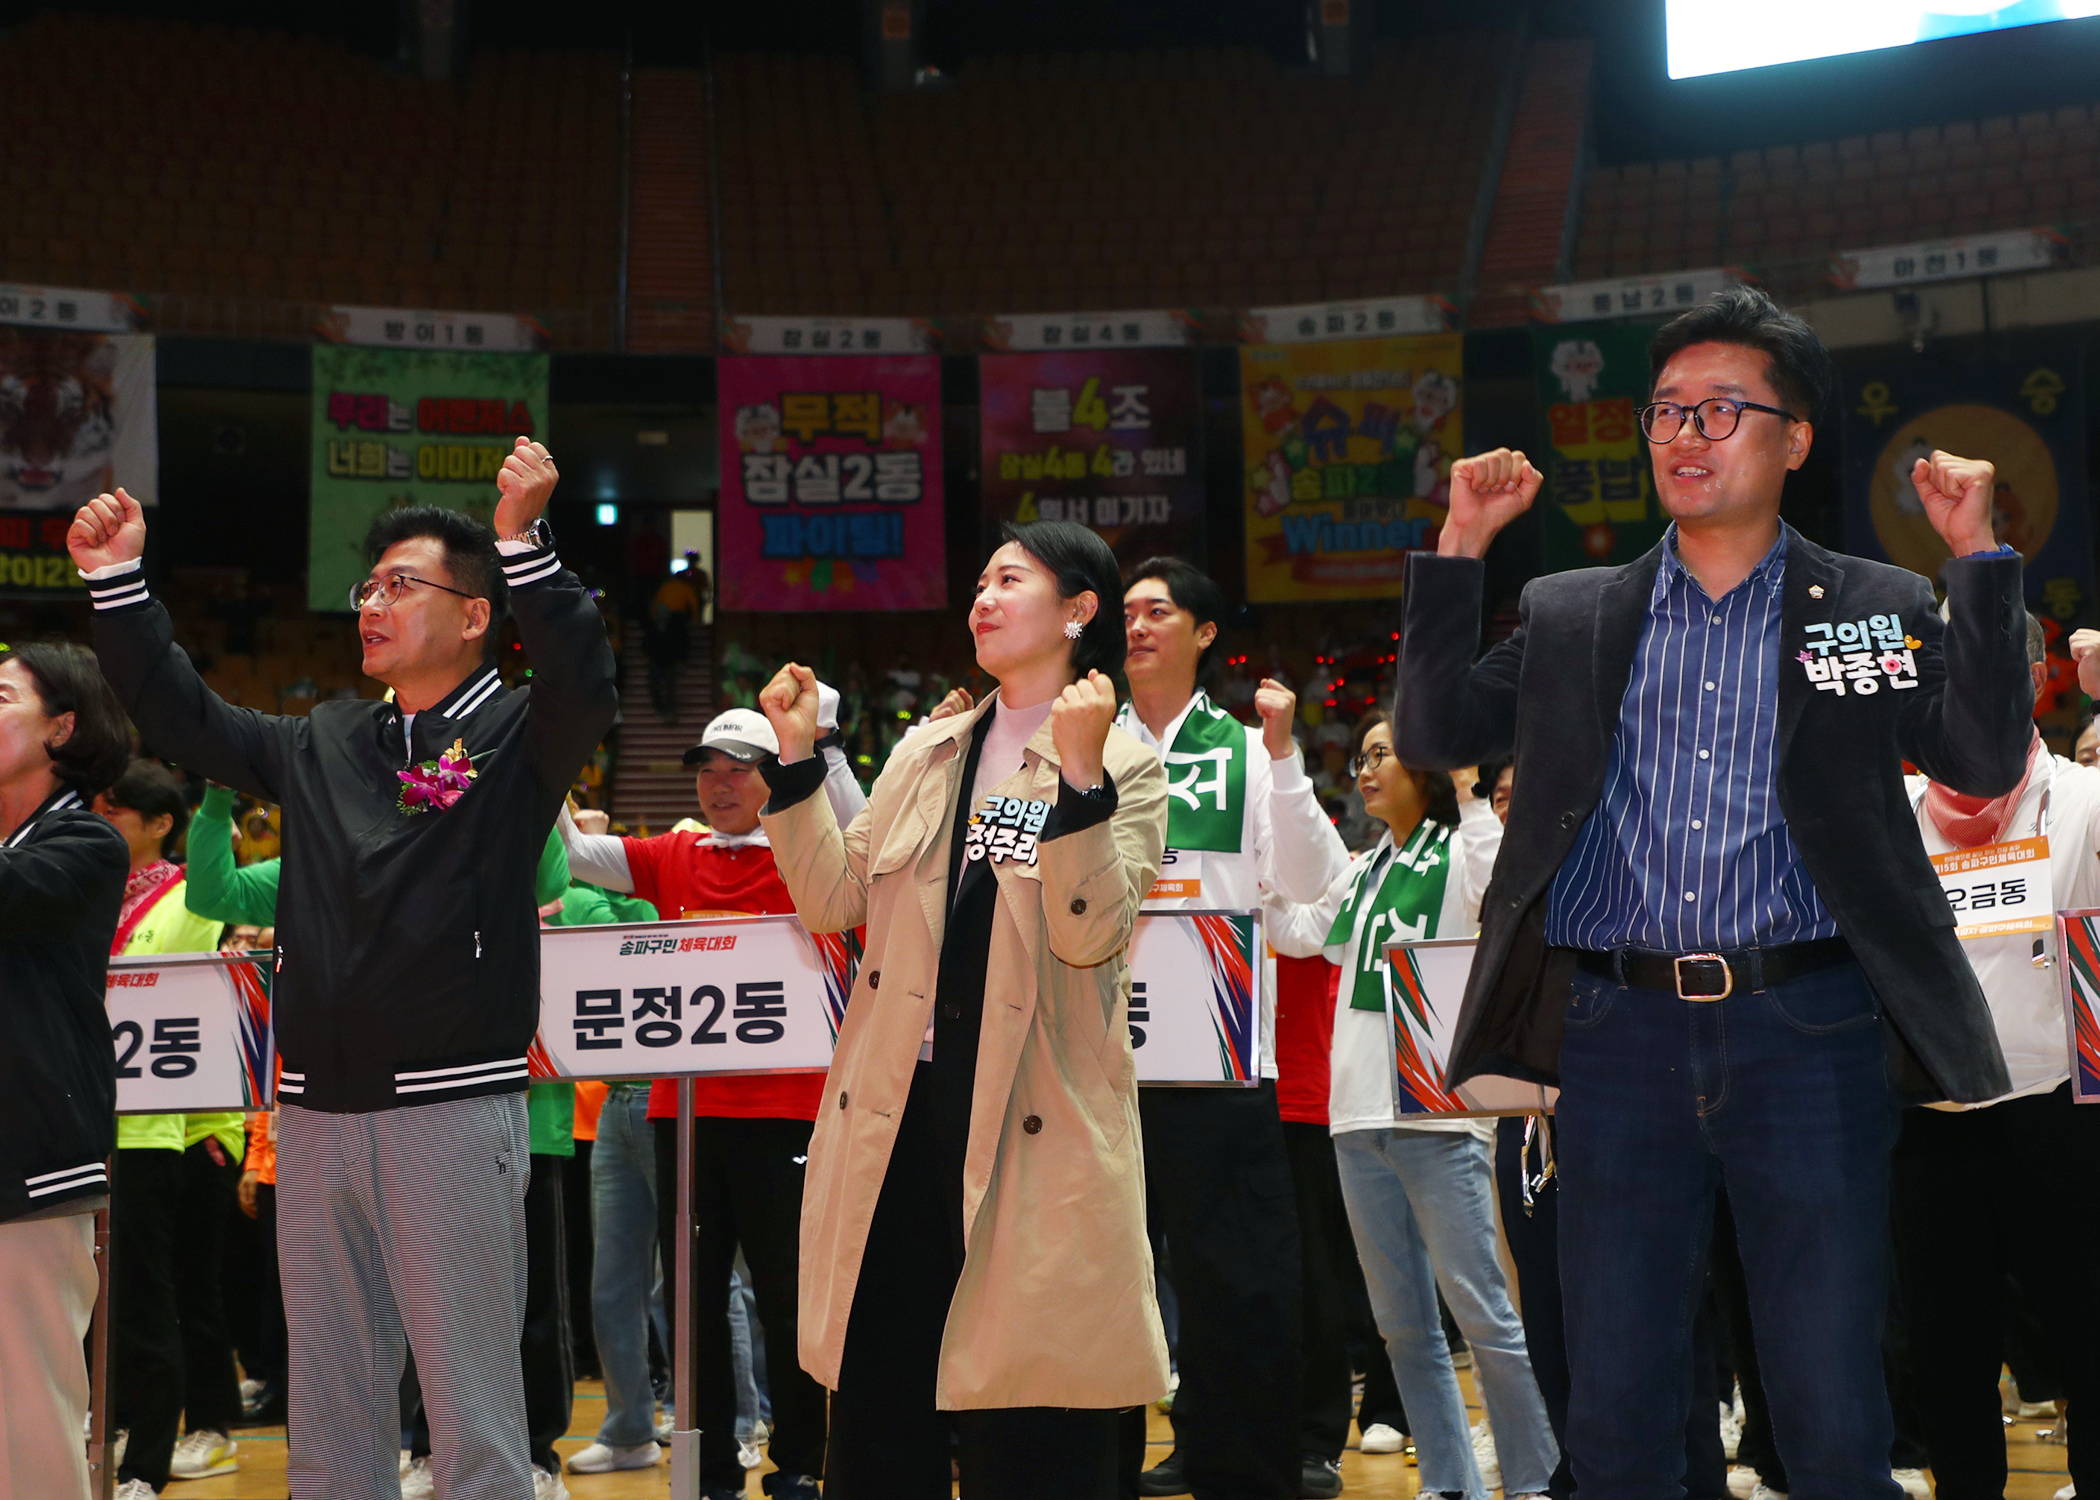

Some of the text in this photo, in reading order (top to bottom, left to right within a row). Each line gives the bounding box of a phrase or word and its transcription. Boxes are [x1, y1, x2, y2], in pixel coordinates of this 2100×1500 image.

[328, 391, 411, 431] 우리는
[781, 392, 882, 443] 무적
[328, 440, 411, 479] 너희는
[743, 450, 922, 503] 잠실2동
[1281, 512, 1432, 555] Winner
[1804, 613, 1906, 657] 구의원
[1803, 649, 1919, 697] 박종현
[979, 795, 1052, 833] 구의원
[965, 823, 1038, 866] 정주리
[1961, 848, 2035, 870] 송파구민체육대회
[1150, 883, 1184, 892] 구체육회
[1945, 878, 2027, 912] 오금동
[619, 935, 738, 956] 송파구민 체육대회
[573, 981, 788, 1051] 문정2동
[113, 1017, 201, 1079] 2동
